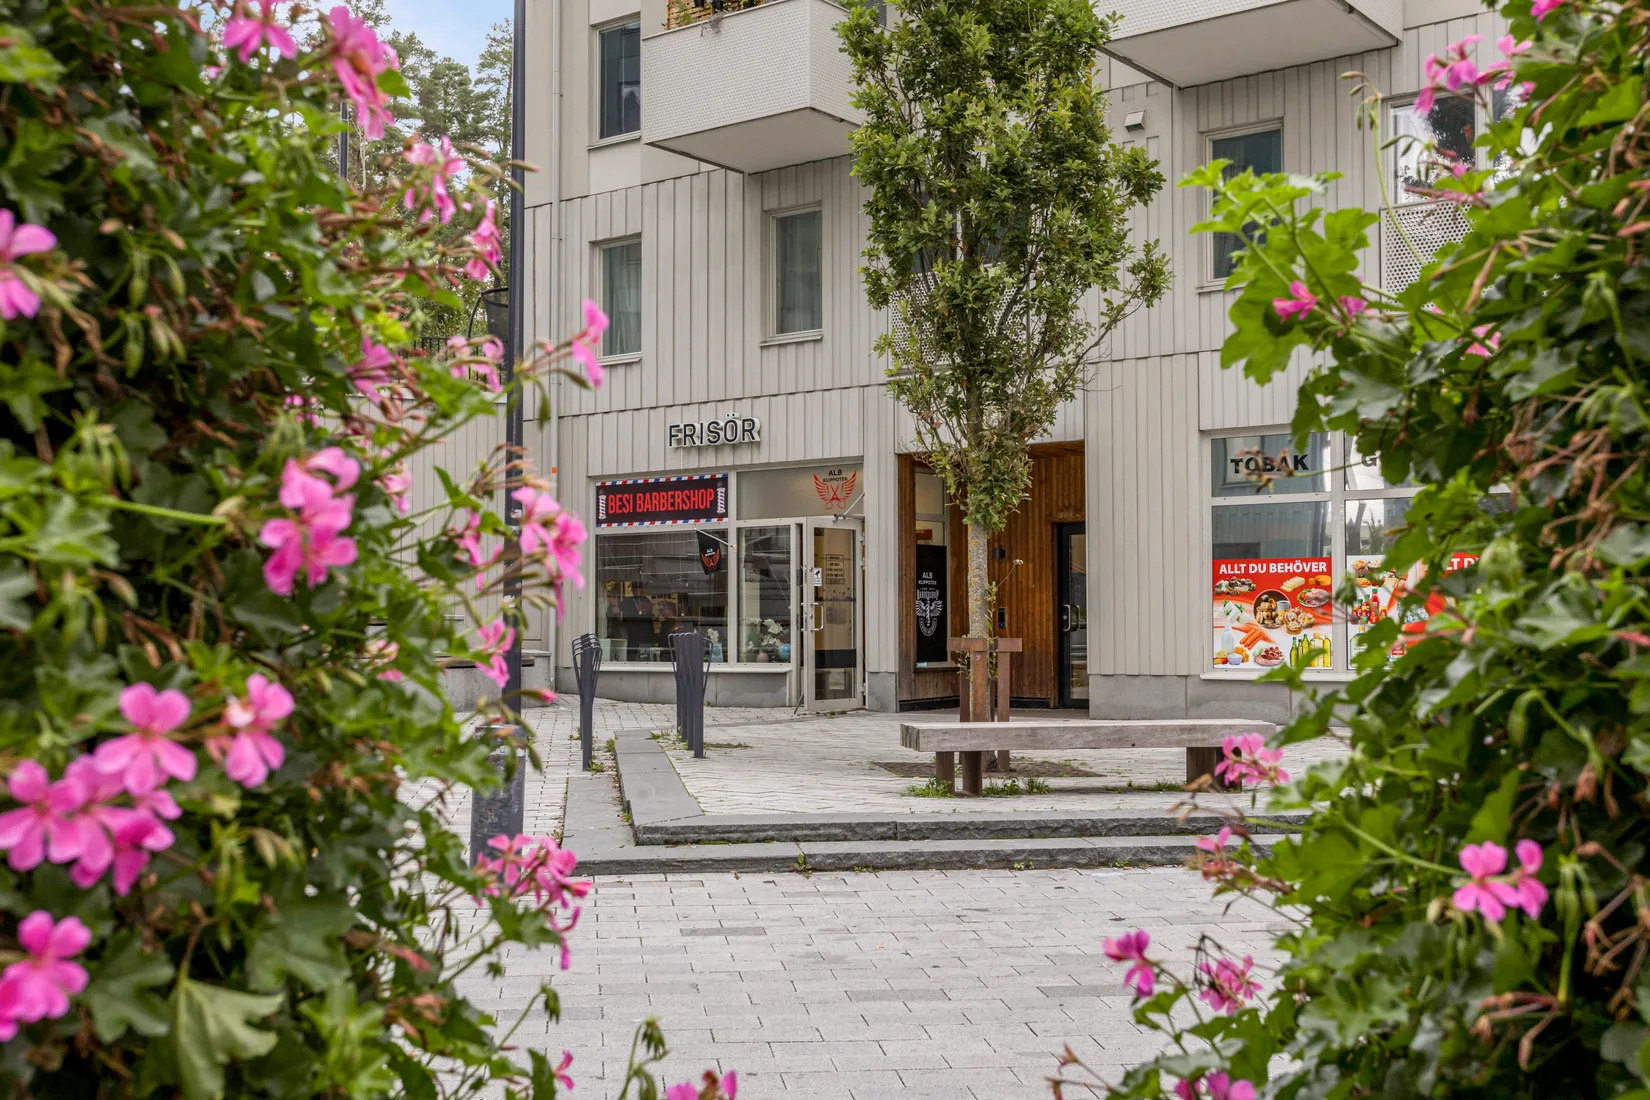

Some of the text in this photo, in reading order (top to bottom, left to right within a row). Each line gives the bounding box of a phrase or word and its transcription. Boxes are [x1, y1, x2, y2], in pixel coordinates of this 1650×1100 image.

[668, 413, 760, 447] FRISÖR
[1230, 454, 1309, 474] TOBAK
[608, 488, 715, 514] BESI BARBERSHOP
[922, 571, 933, 579] ALB
[1219, 560, 1327, 575] ALLT DU BEHÖVER
